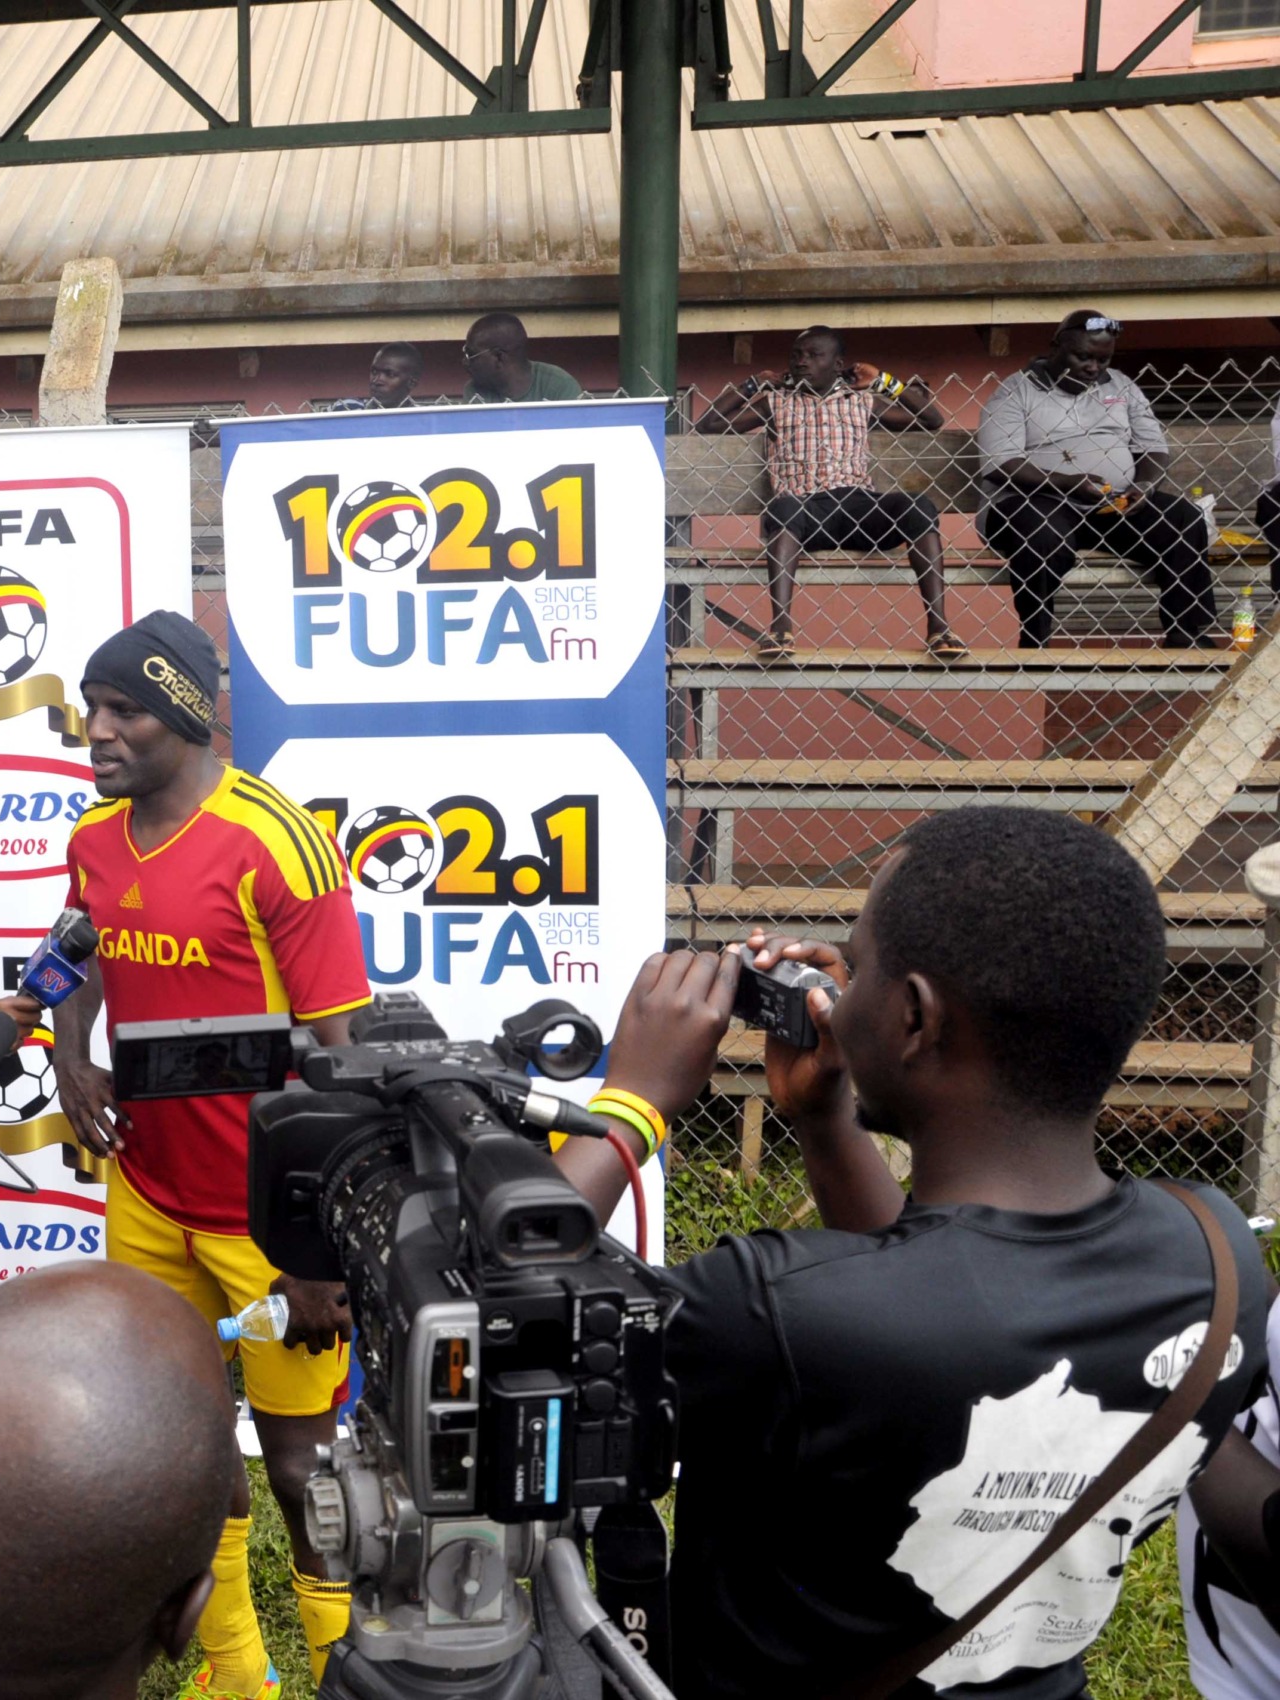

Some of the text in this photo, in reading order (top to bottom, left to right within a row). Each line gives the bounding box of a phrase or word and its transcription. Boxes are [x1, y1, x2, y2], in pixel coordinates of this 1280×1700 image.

[534, 586, 597, 603] SINCE
[542, 604, 597, 621] 2015
[293, 585, 550, 669] FUFA
[550, 627, 597, 661] fm
[0, 837, 48, 856] 2008
[538, 912, 600, 929] SINCE
[95, 927, 211, 967] GANDA
[357, 910, 553, 985] UFA
[545, 930, 600, 946] 2015
[37, 967, 72, 993] NTV
[553, 951, 599, 983] fm
[972, 1471, 1100, 1501] A MOVING VILLA
[953, 1508, 1013, 1534] THROUGH
